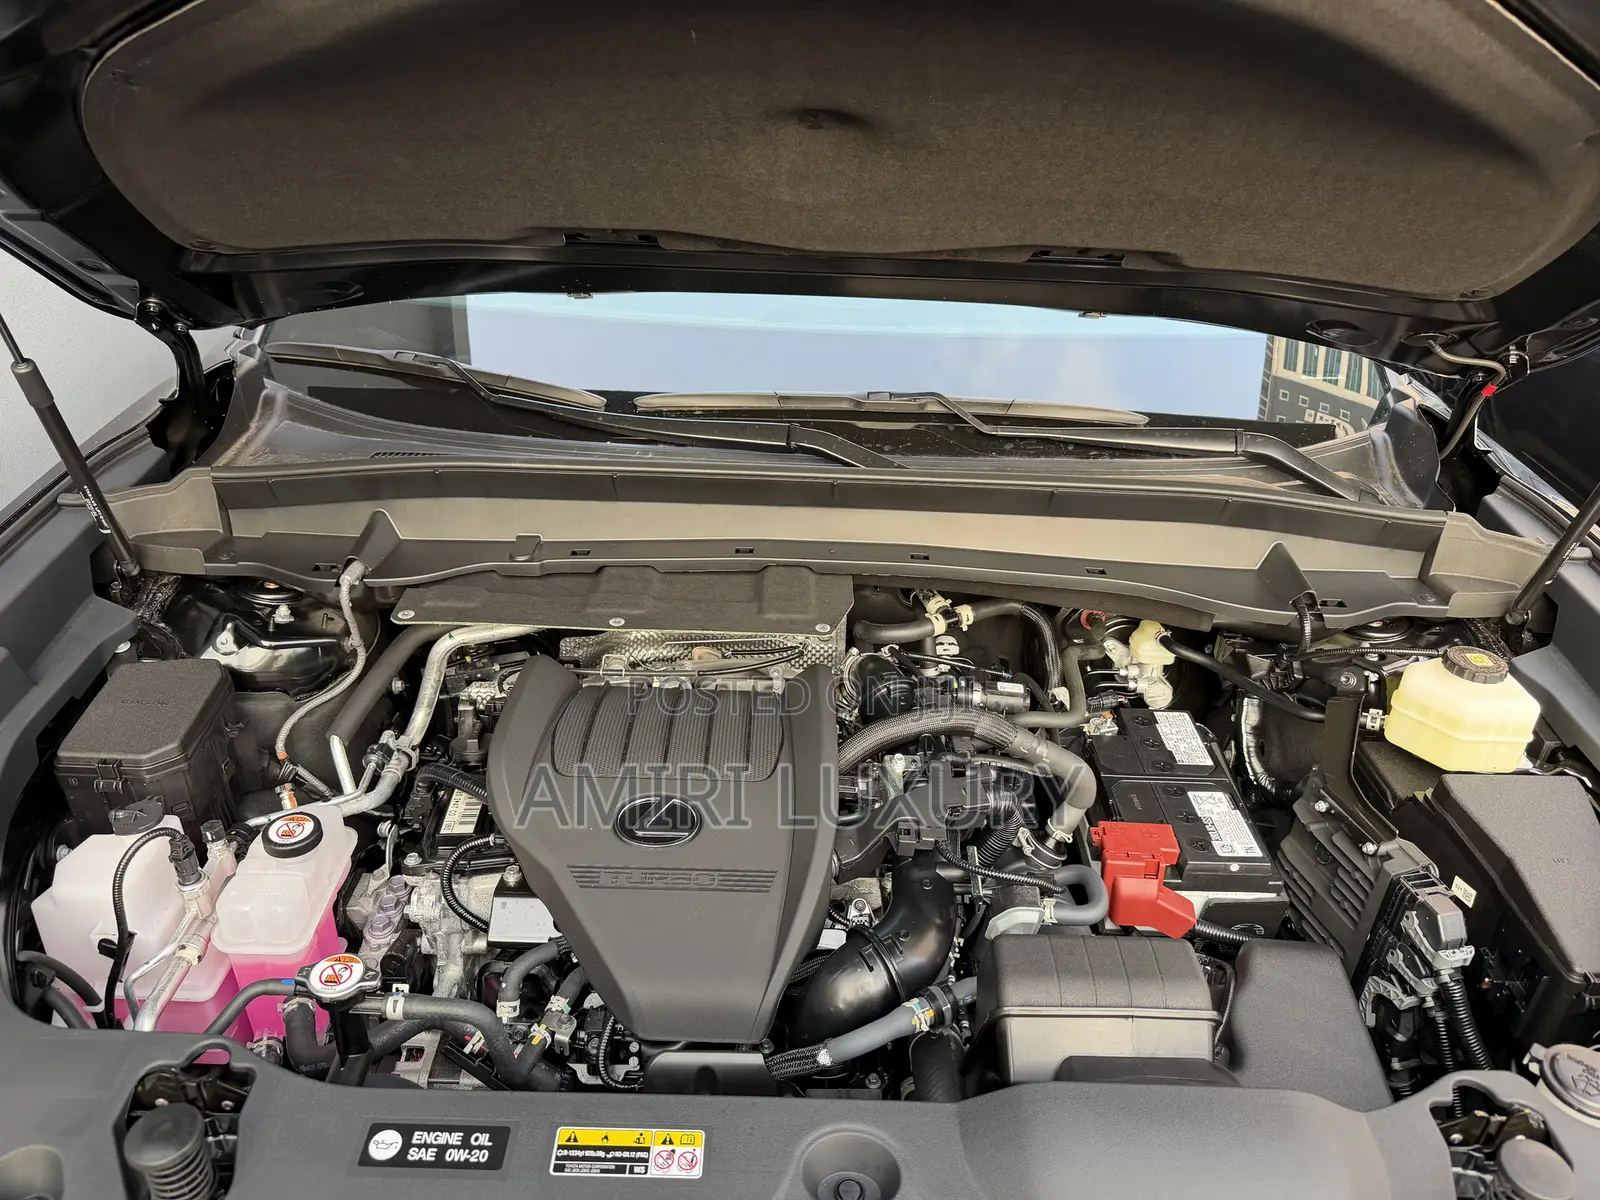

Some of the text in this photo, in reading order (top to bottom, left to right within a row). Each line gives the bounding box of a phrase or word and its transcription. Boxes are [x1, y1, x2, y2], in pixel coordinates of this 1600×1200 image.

[602, 870, 716, 887] TURBO
[411, 1131, 493, 1146] ENGINE OIL
[407, 1147, 489, 1163] SAE 0W-20
[633, 1166, 646, 1174] WS
